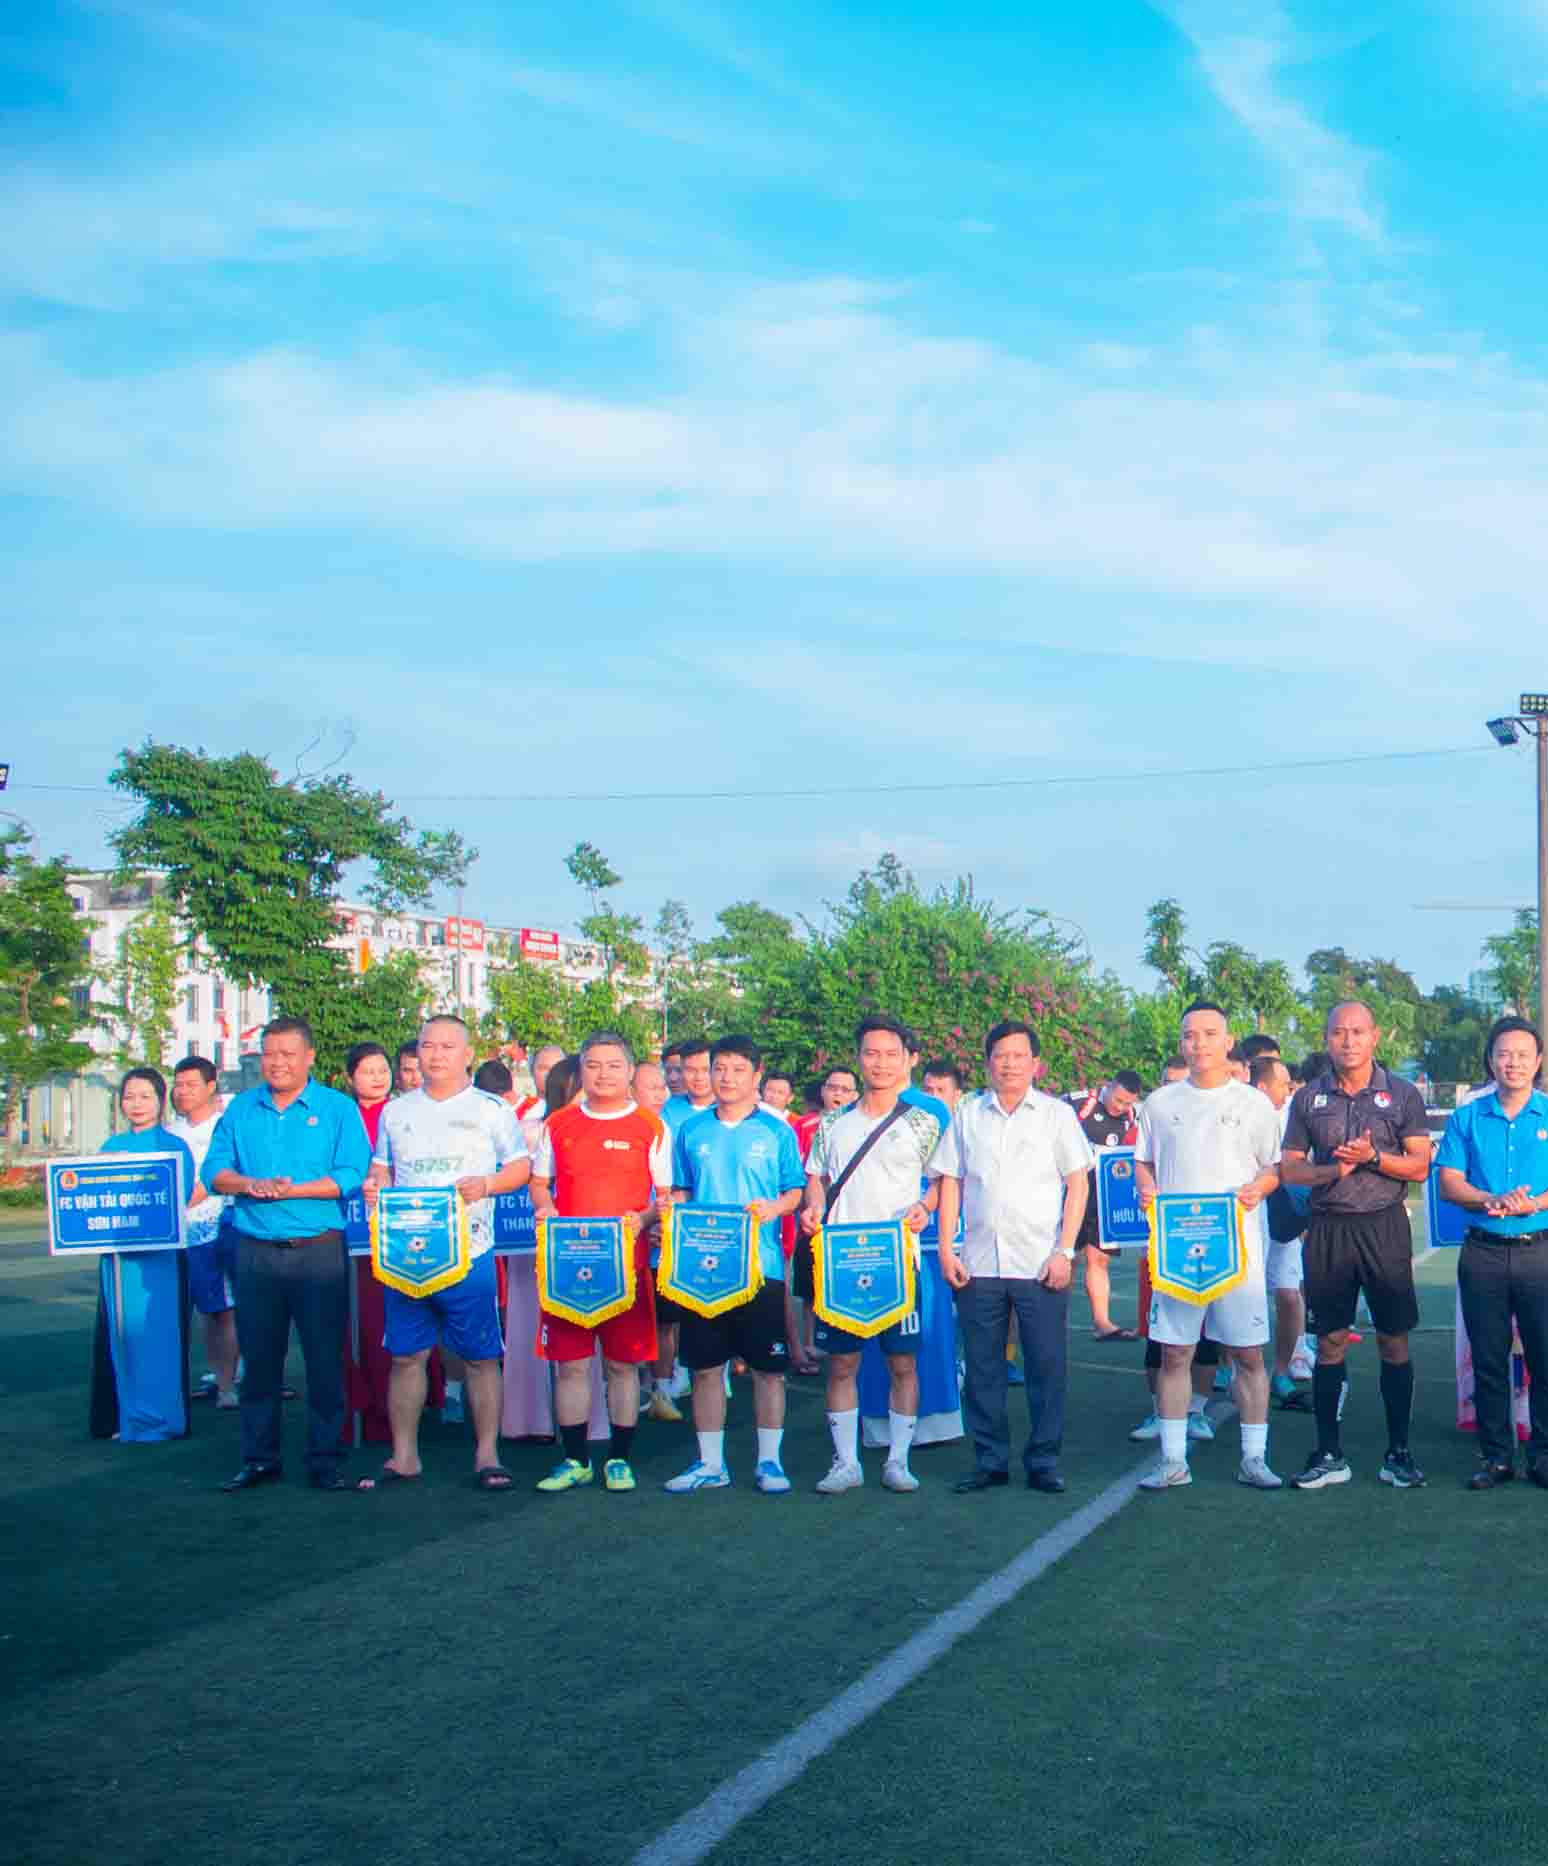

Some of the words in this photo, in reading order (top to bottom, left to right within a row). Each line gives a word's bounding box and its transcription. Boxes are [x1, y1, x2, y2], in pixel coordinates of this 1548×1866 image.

[60, 1196, 73, 1210] FC
[74, 1192, 97, 1212] VẬN
[99, 1189, 117, 1208] TẢI
[153, 1186, 169, 1206] TẾ
[500, 1195, 515, 1209] FC
[112, 1215, 139, 1228] NAM
[900, 1311, 921, 1337] 10
